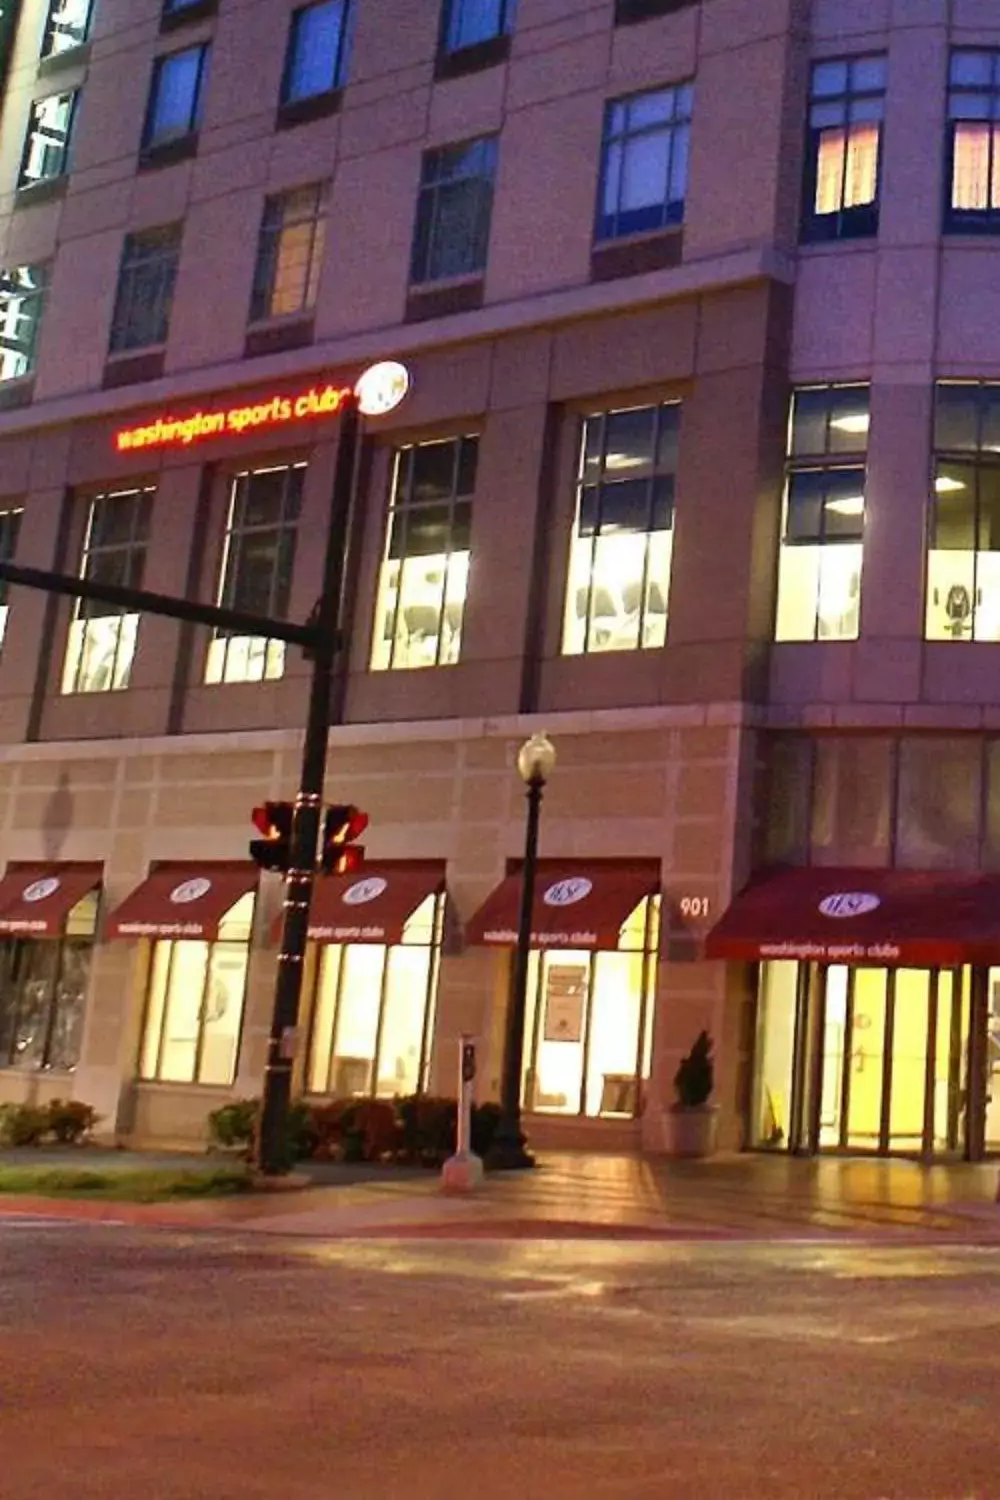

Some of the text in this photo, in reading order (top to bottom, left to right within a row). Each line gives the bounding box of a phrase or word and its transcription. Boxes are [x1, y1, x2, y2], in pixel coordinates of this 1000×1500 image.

[117, 411, 225, 450] washington
[226, 396, 292, 432] sports
[680, 896, 709, 917] 901
